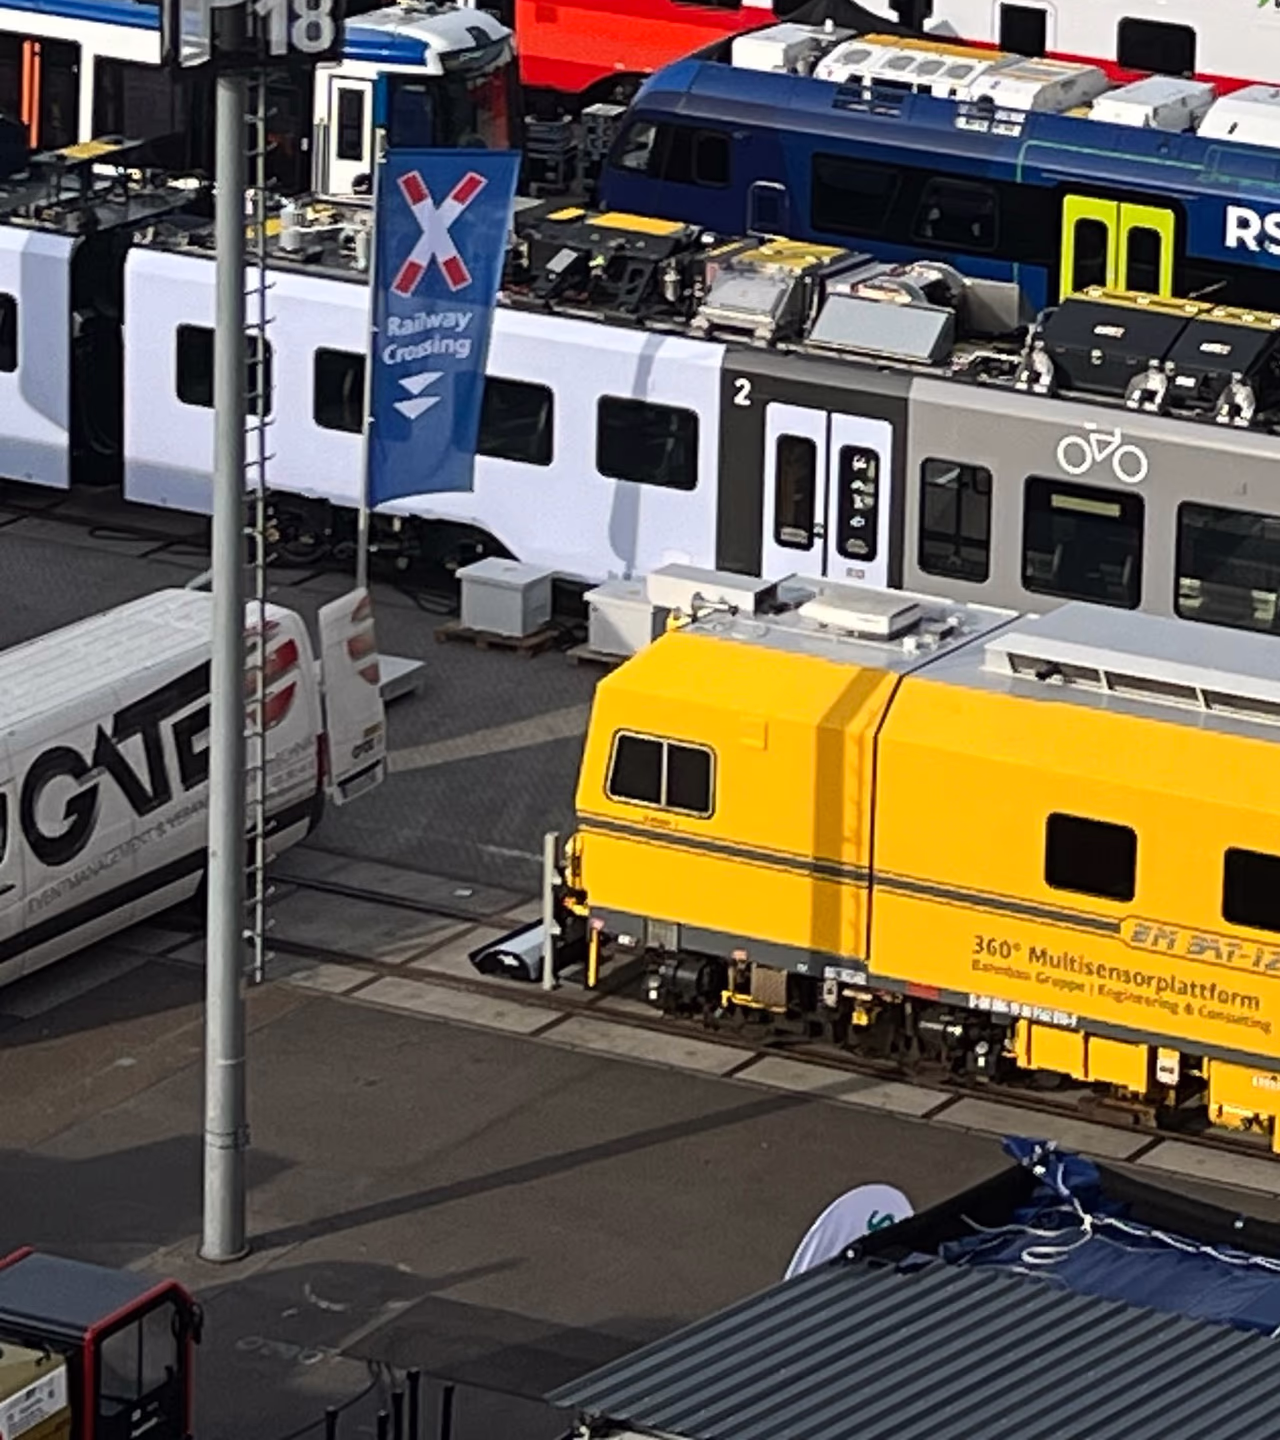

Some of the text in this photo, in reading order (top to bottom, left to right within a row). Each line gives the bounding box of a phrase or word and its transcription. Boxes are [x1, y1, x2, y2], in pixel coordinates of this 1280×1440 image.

[386, 311, 473, 338] Railway
[381, 335, 473, 366] Crossing
[733, 377, 752, 407] 2
[971, 934, 1022, 961] 360°
[1028, 945, 1261, 1011] Multisensorplattform
[1097, 982, 1180, 1017] Engineering
